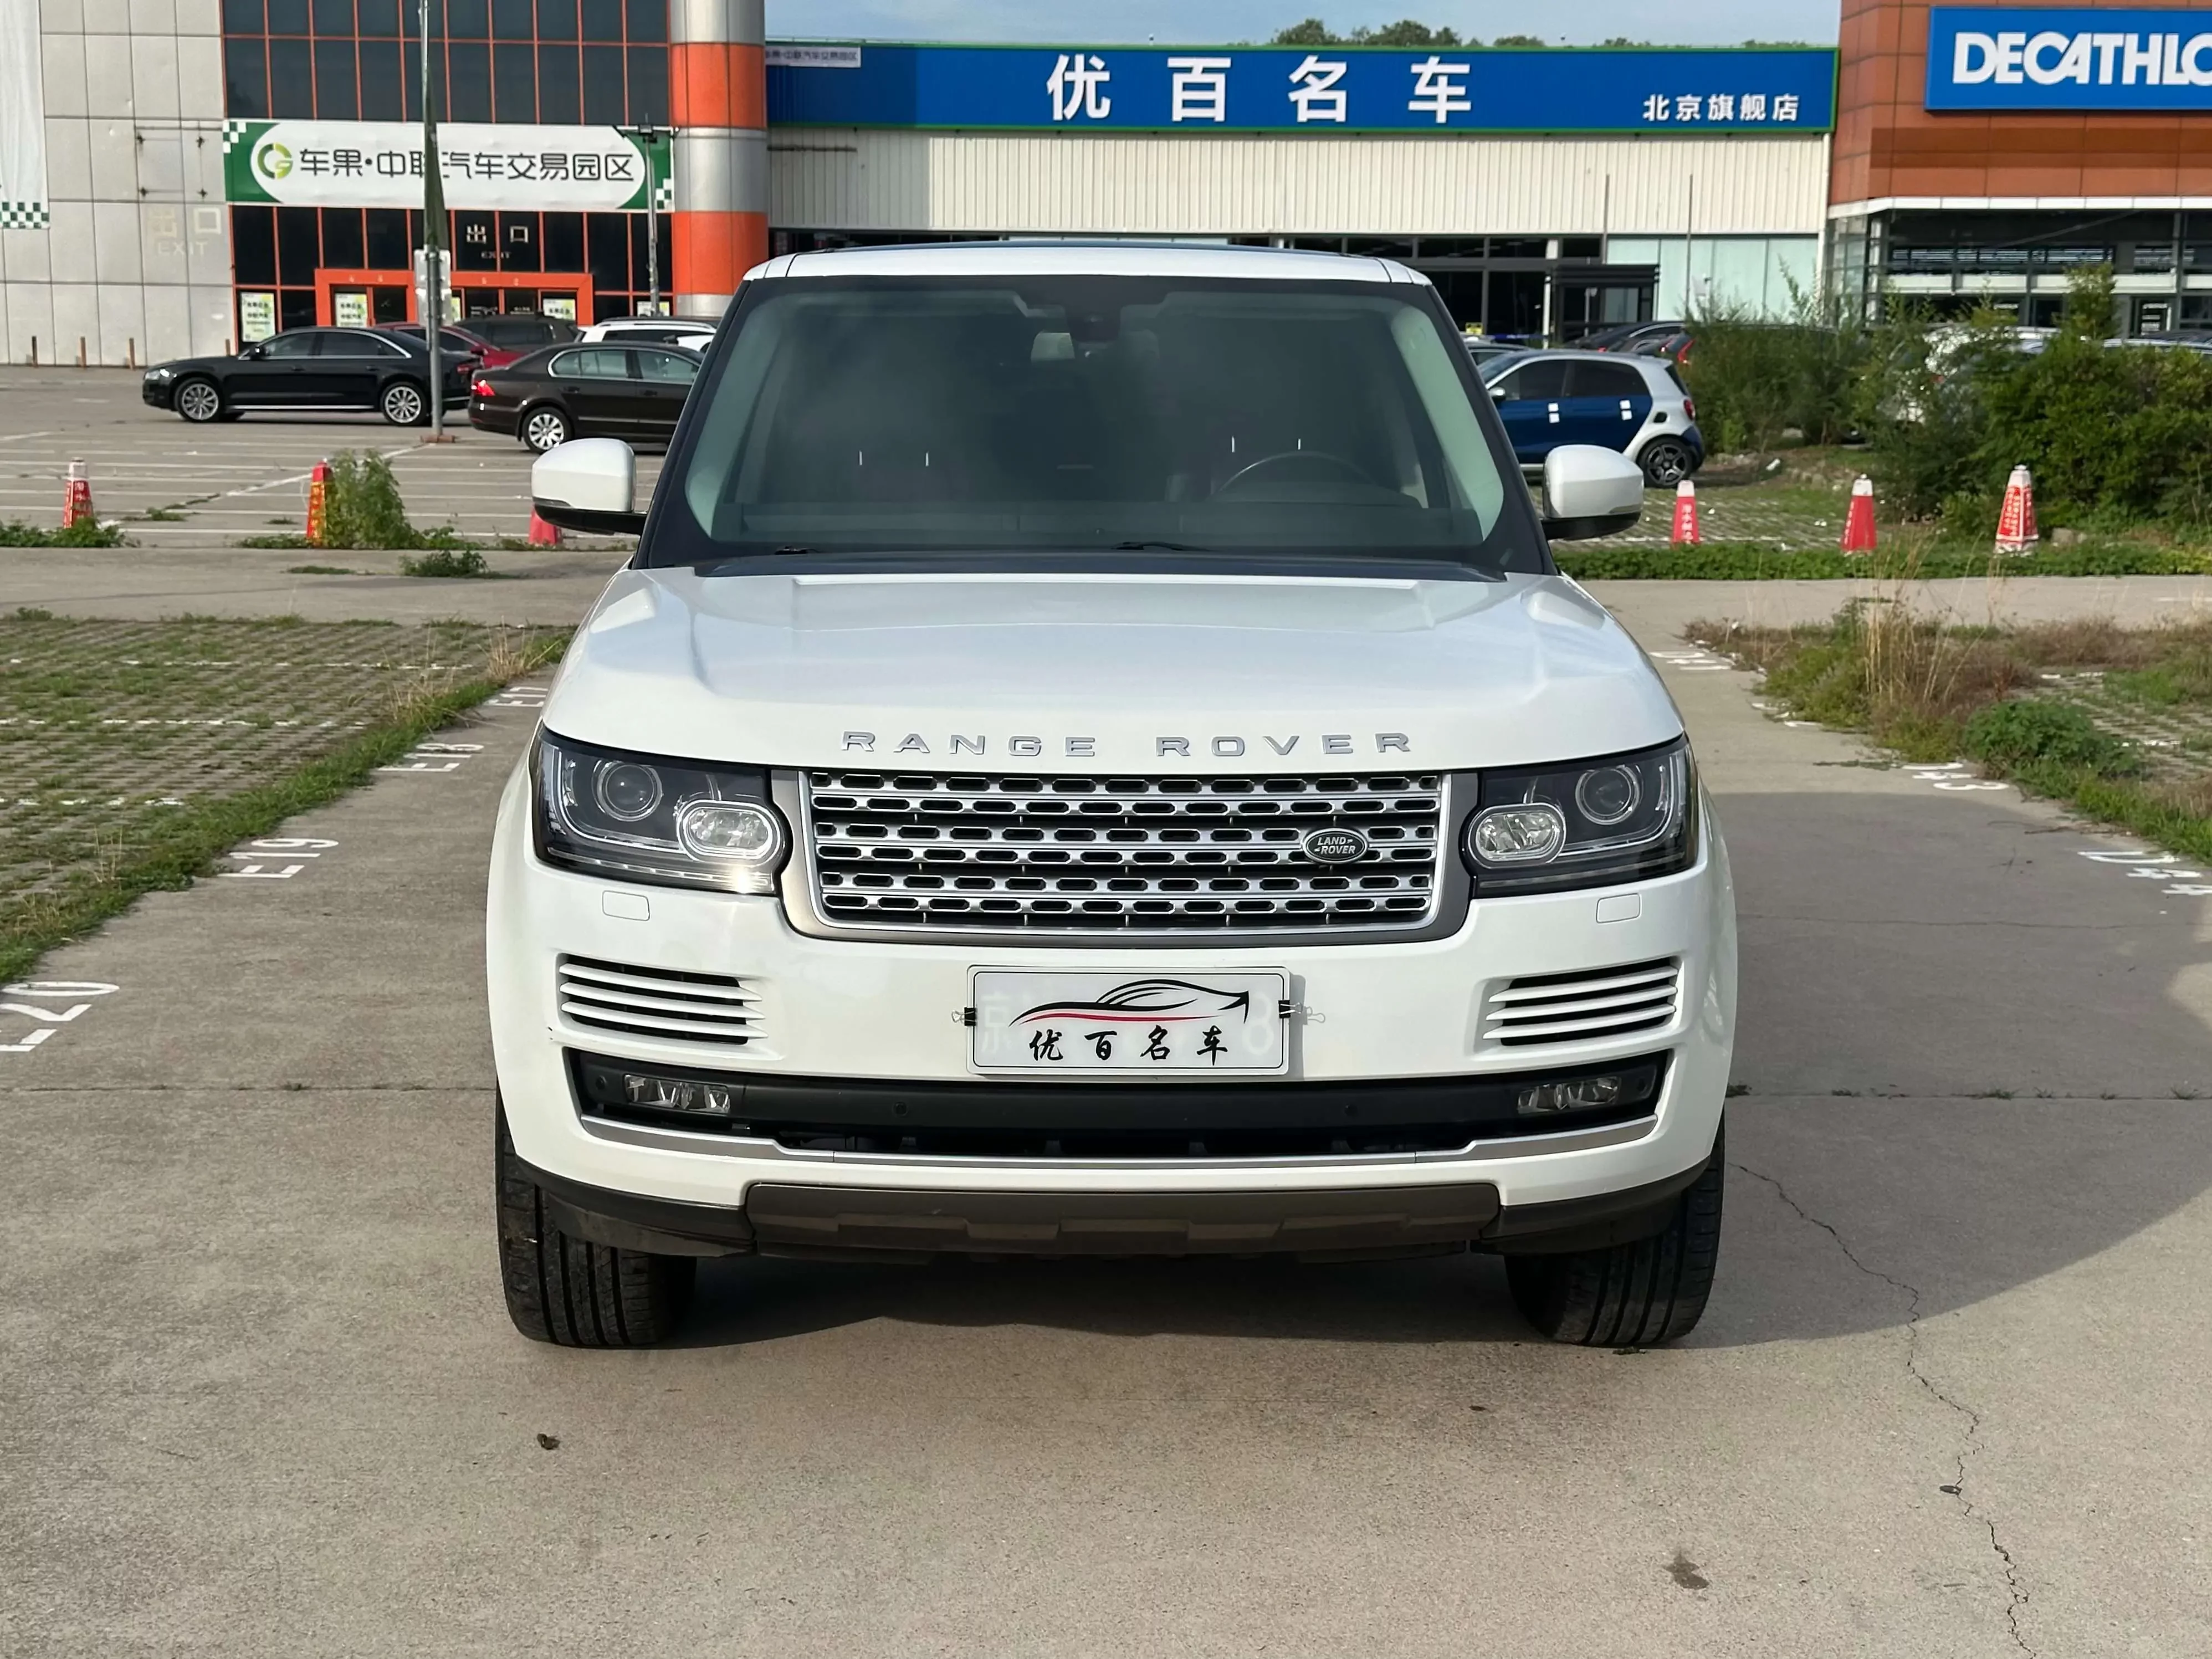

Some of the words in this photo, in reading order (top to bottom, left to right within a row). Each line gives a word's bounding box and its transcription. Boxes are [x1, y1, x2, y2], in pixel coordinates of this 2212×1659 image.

[1046, 54, 1472, 124] 优百名车
[1642, 93, 1799, 122] 北京旗舰店
[466, 224, 529, 244] 出口
[157, 242, 208, 255] EXIT
[377, 743, 484, 772] E18
[841, 730, 1096, 757] RANGE
[1155, 733, 1411, 757] ROVER
[1317, 837, 1346, 846] LAND
[1320, 845, 1356, 854] ROVER
[217, 838, 339, 878] E19
[1028, 1024, 1228, 1066] 优百名车
